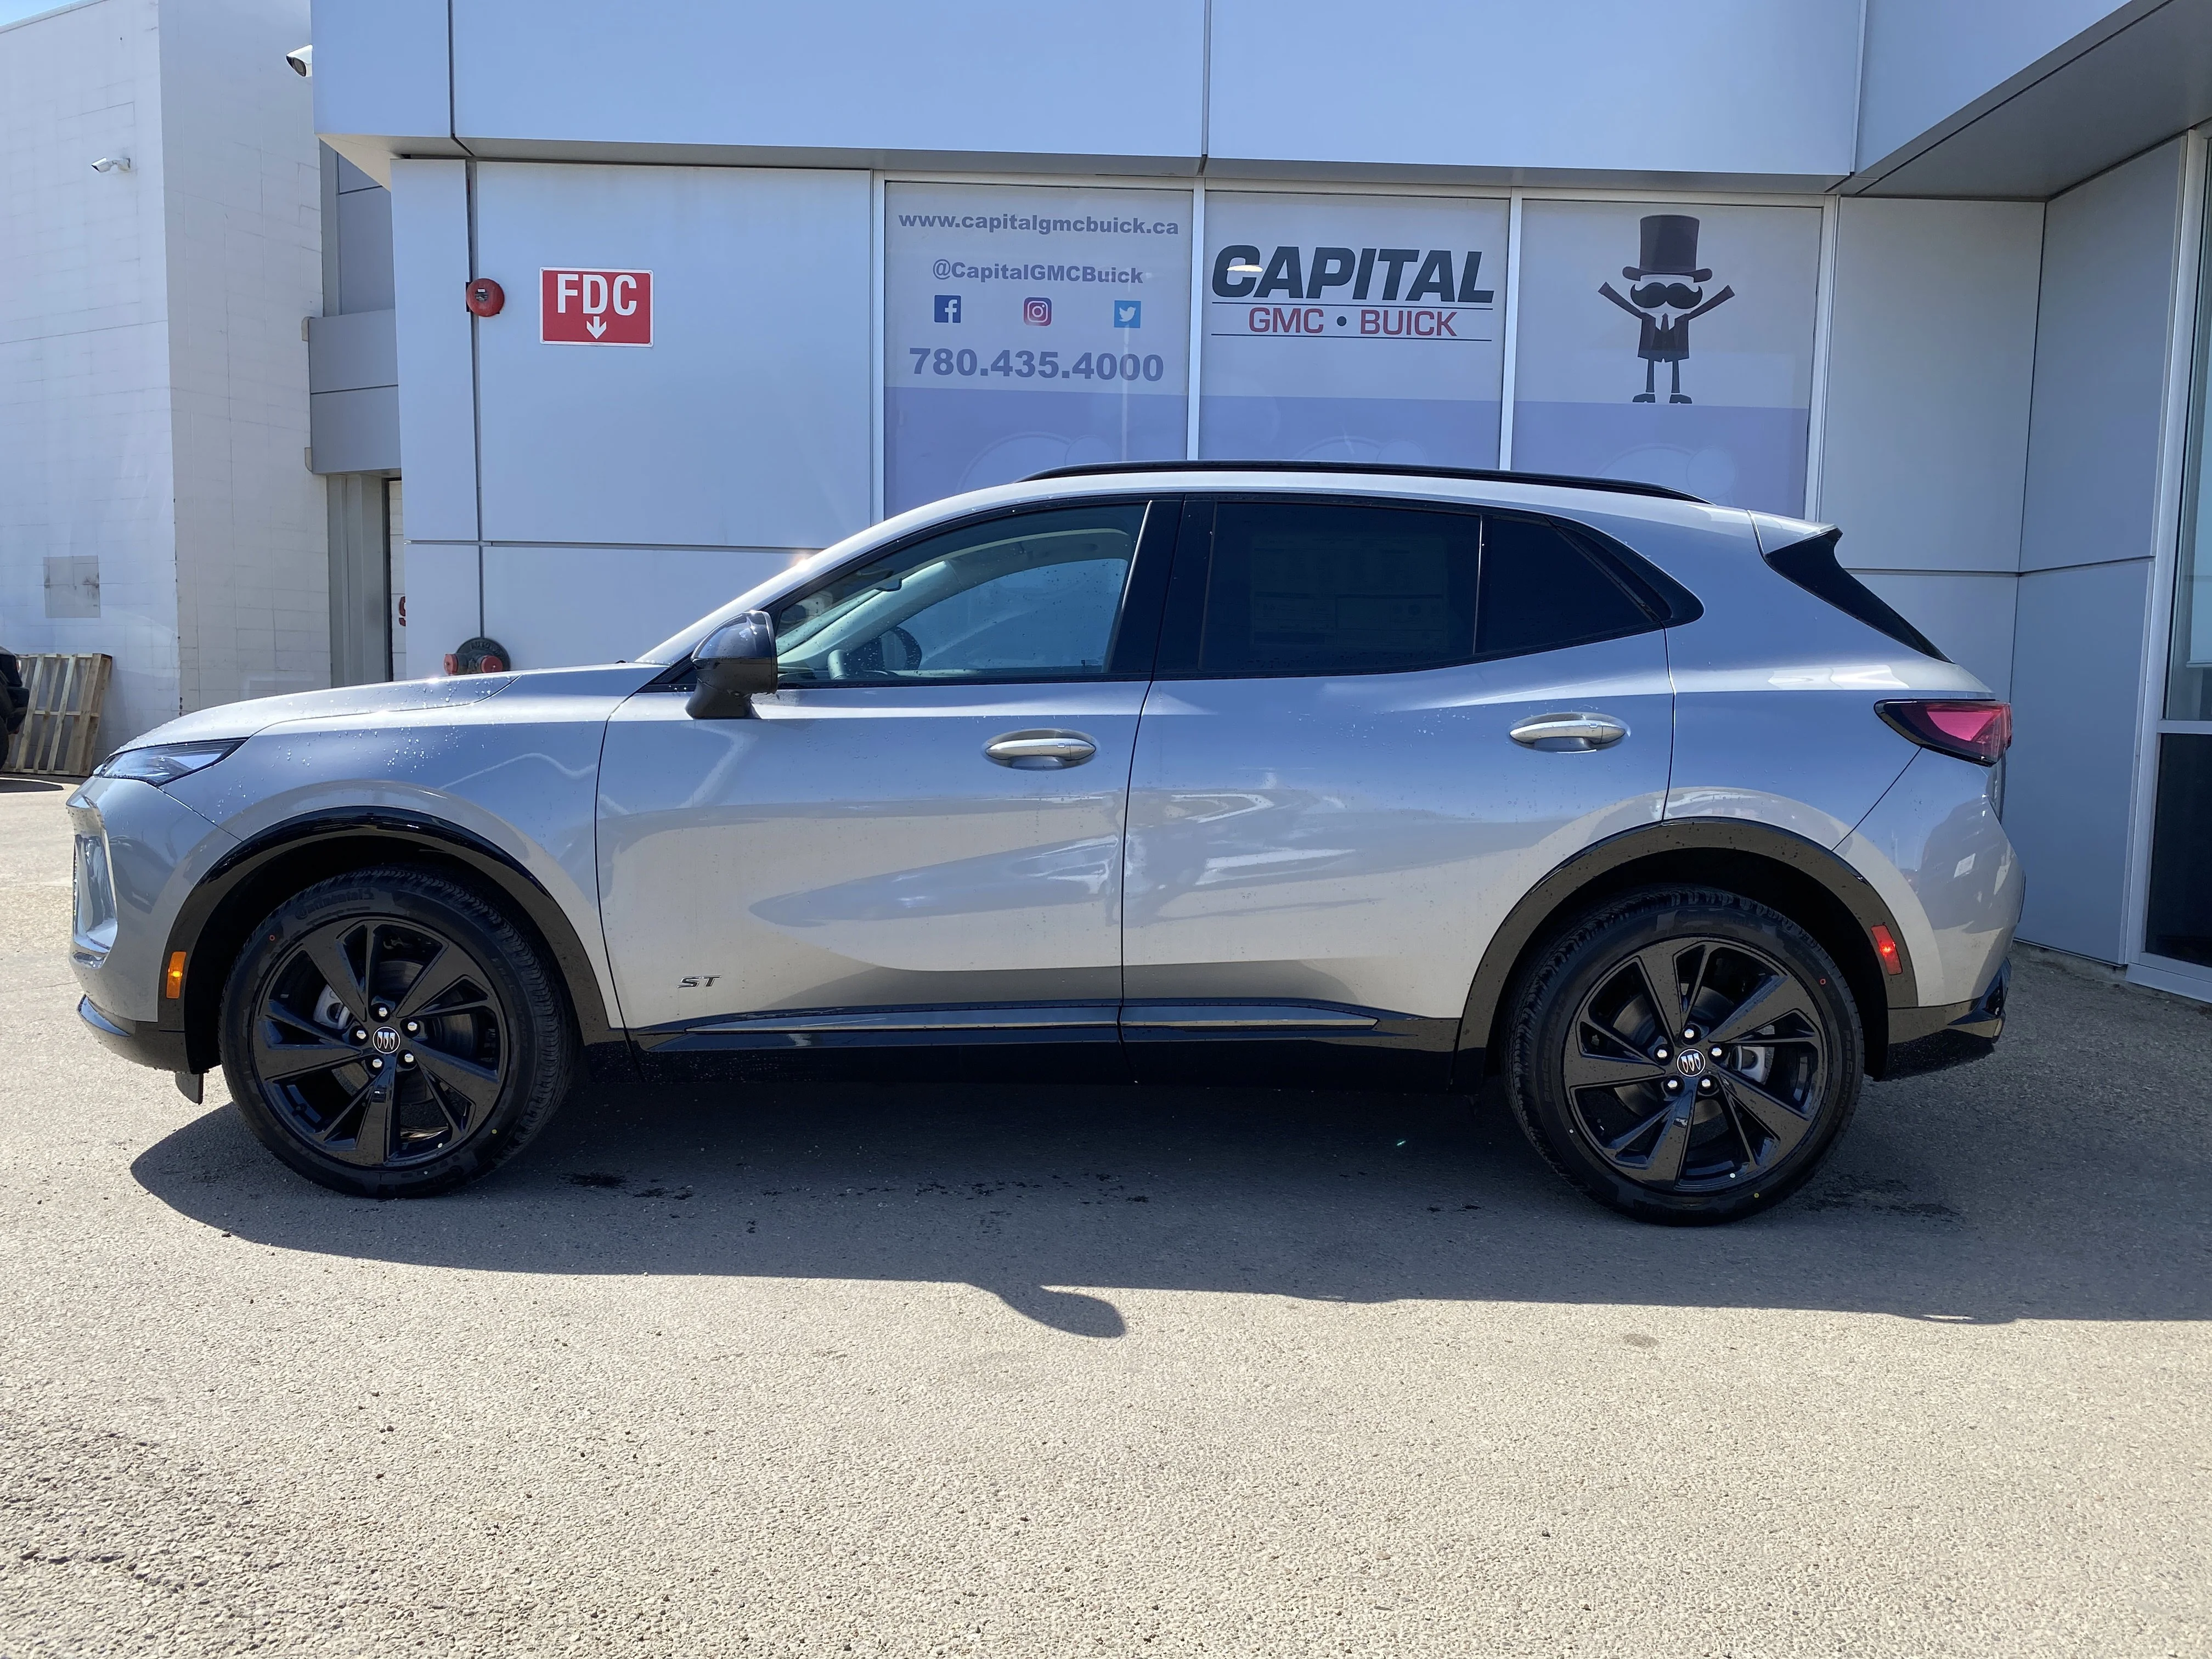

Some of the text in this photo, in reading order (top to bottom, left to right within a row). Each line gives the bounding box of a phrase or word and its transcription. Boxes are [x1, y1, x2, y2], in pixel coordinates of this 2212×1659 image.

[899, 213, 1179, 235] www.capitalgmcbuick.ca
[933, 259, 1143, 284] @CapitalGMCBuick
[1212, 244, 1494, 303] CAPITAL
[557, 274, 637, 316] FDC
[1249, 307, 1458, 336] GMC BUICK
[909, 348, 1164, 382] 780.435.4000
[677, 975, 723, 988] ST
